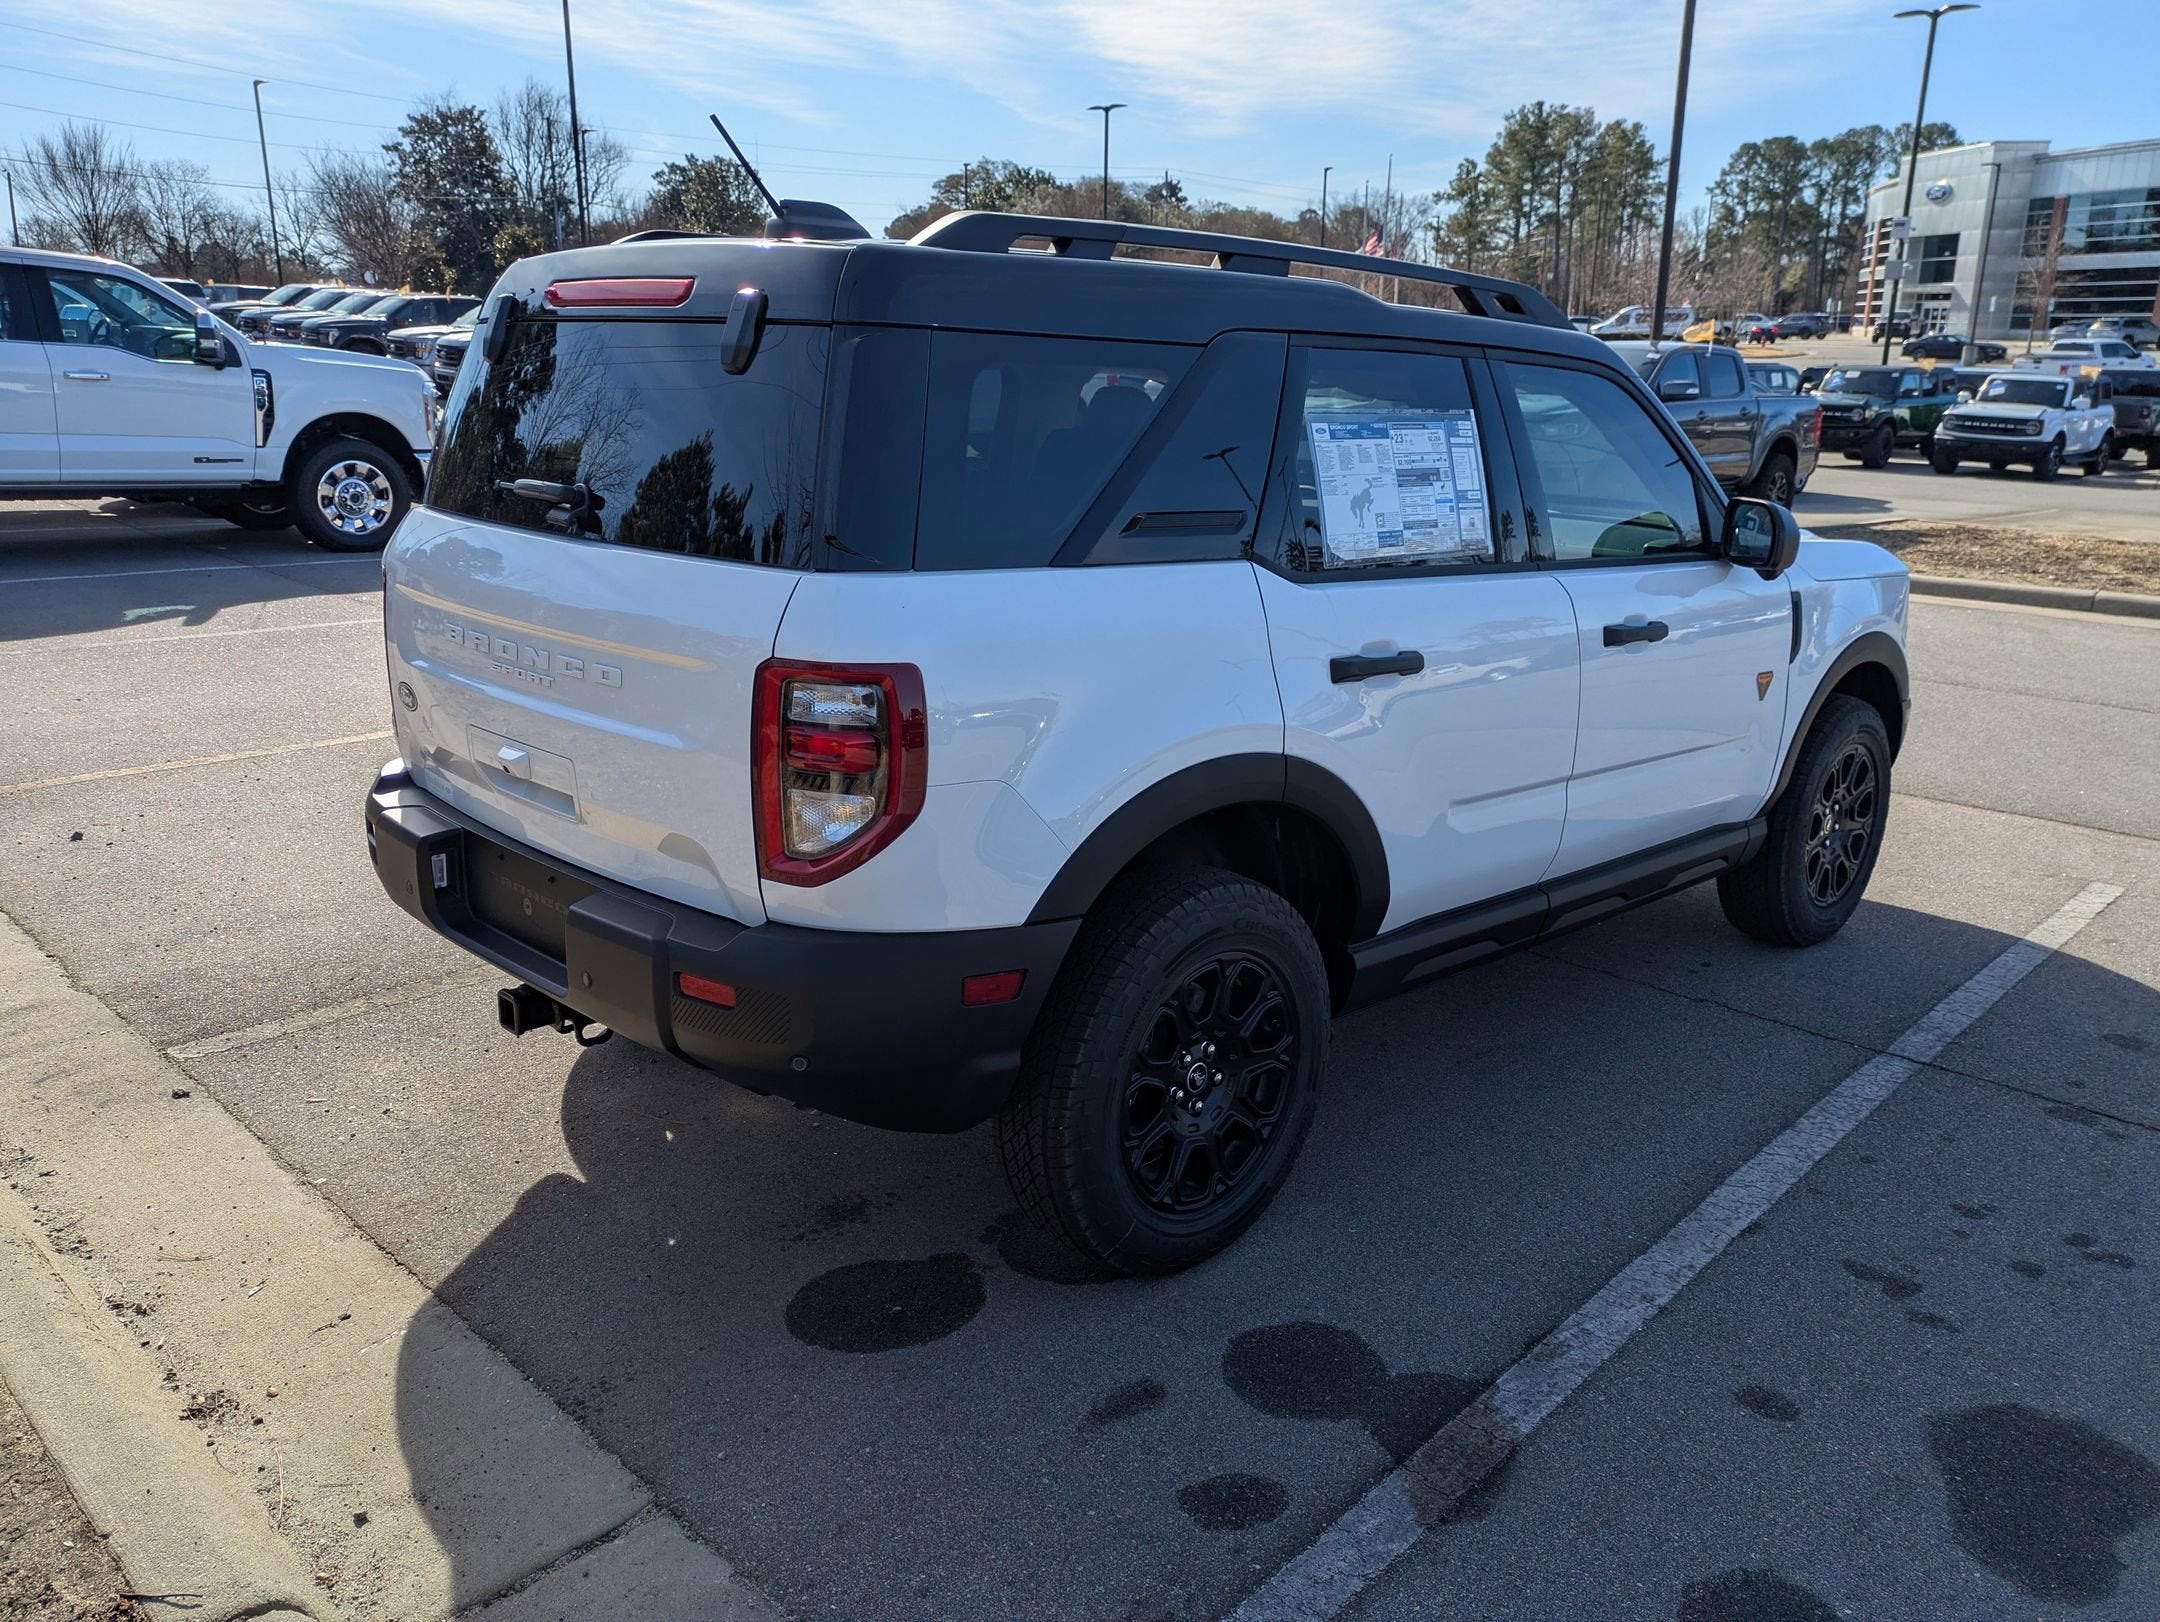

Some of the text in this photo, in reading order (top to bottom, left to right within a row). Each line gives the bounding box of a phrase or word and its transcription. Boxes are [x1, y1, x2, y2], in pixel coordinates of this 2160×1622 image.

[1394, 433, 1404, 443] 23
[446, 623, 623, 688] BRONCO
[489, 660, 555, 687] SPORT
